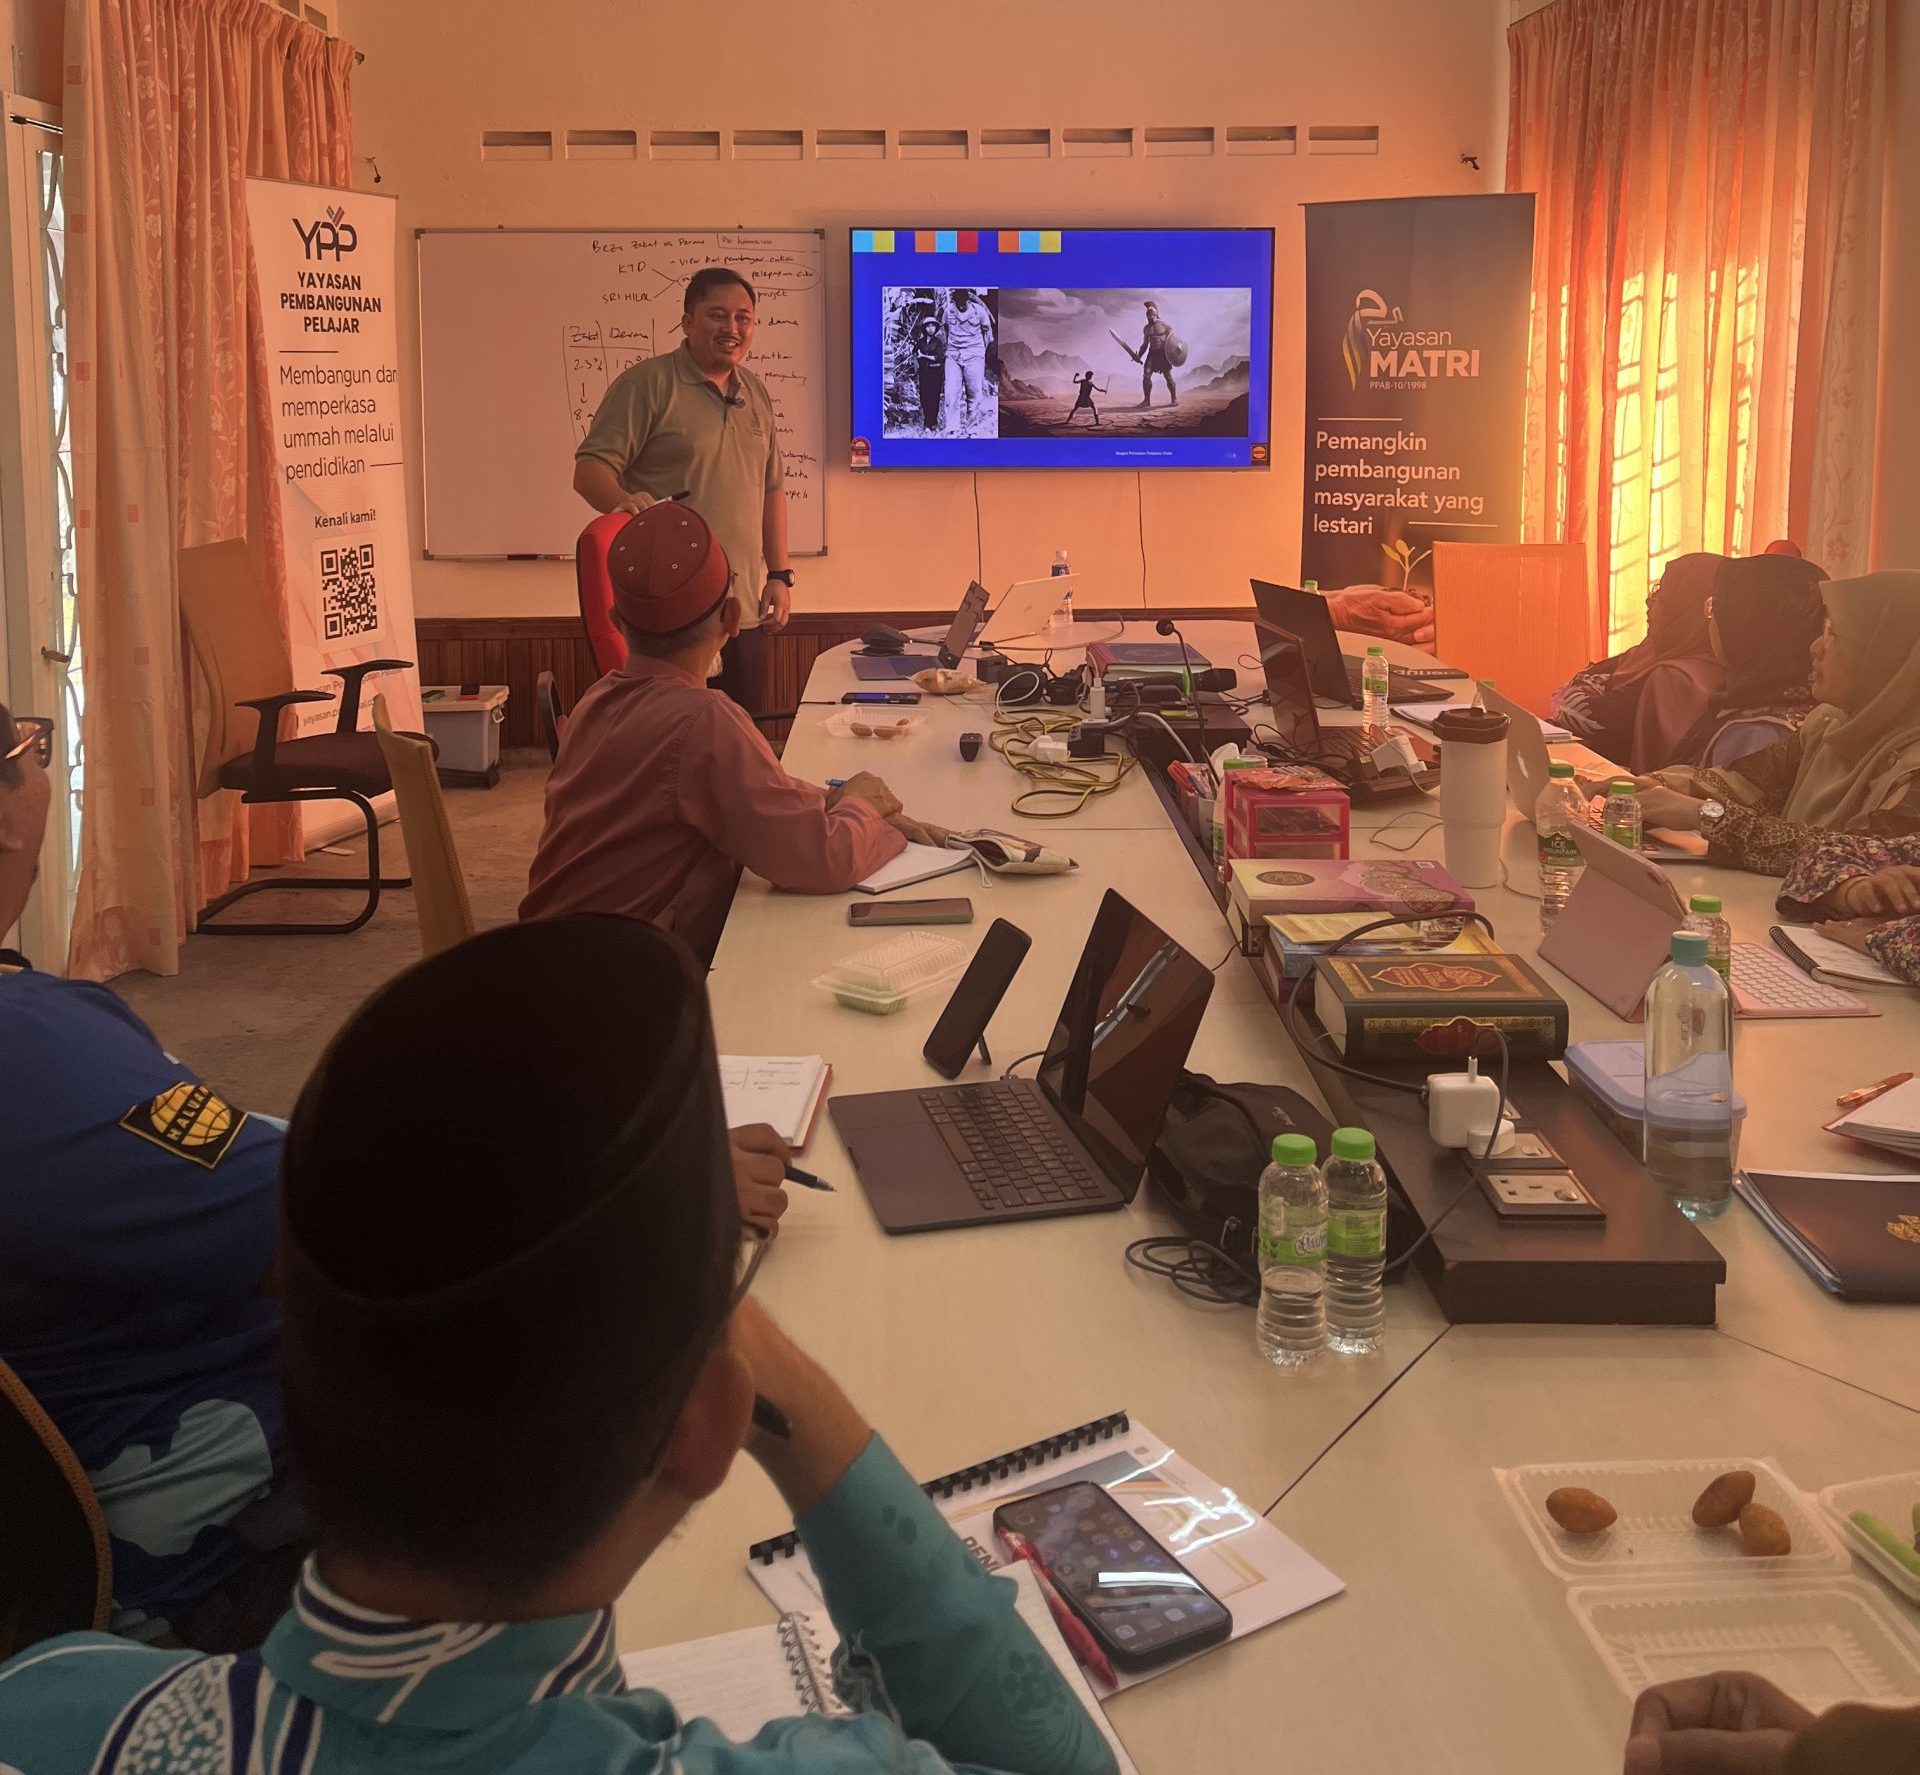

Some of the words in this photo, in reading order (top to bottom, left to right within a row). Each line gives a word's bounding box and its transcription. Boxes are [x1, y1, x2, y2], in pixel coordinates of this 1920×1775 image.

[292, 217, 358, 262] YPP
[298, 271, 361, 290] YAYASAN
[280, 293, 382, 313] PEMBANGUNAN
[303, 316, 360, 333] PELAJAR
[1366, 327, 1452, 349] Yayasan
[1369, 349, 1480, 378] MATRI
[279, 364, 371, 387] Membangun
[1369, 381, 1427, 390] PPAB-10/1998
[281, 396, 376, 419] memperkasa
[283, 426, 341, 448] ummah
[344, 422, 394, 444] melalui
[1316, 431, 1427, 455] Pemangkin
[285, 456, 366, 483] pendidikan
[1315, 459, 1461, 484] pembangunan
[1314, 488, 1429, 512] masyarakat
[1433, 495, 1485, 516] yang
[314, 512, 348, 529] Kenali
[350, 509, 377, 524] kami!
[1313, 514, 1374, 534] lestari
